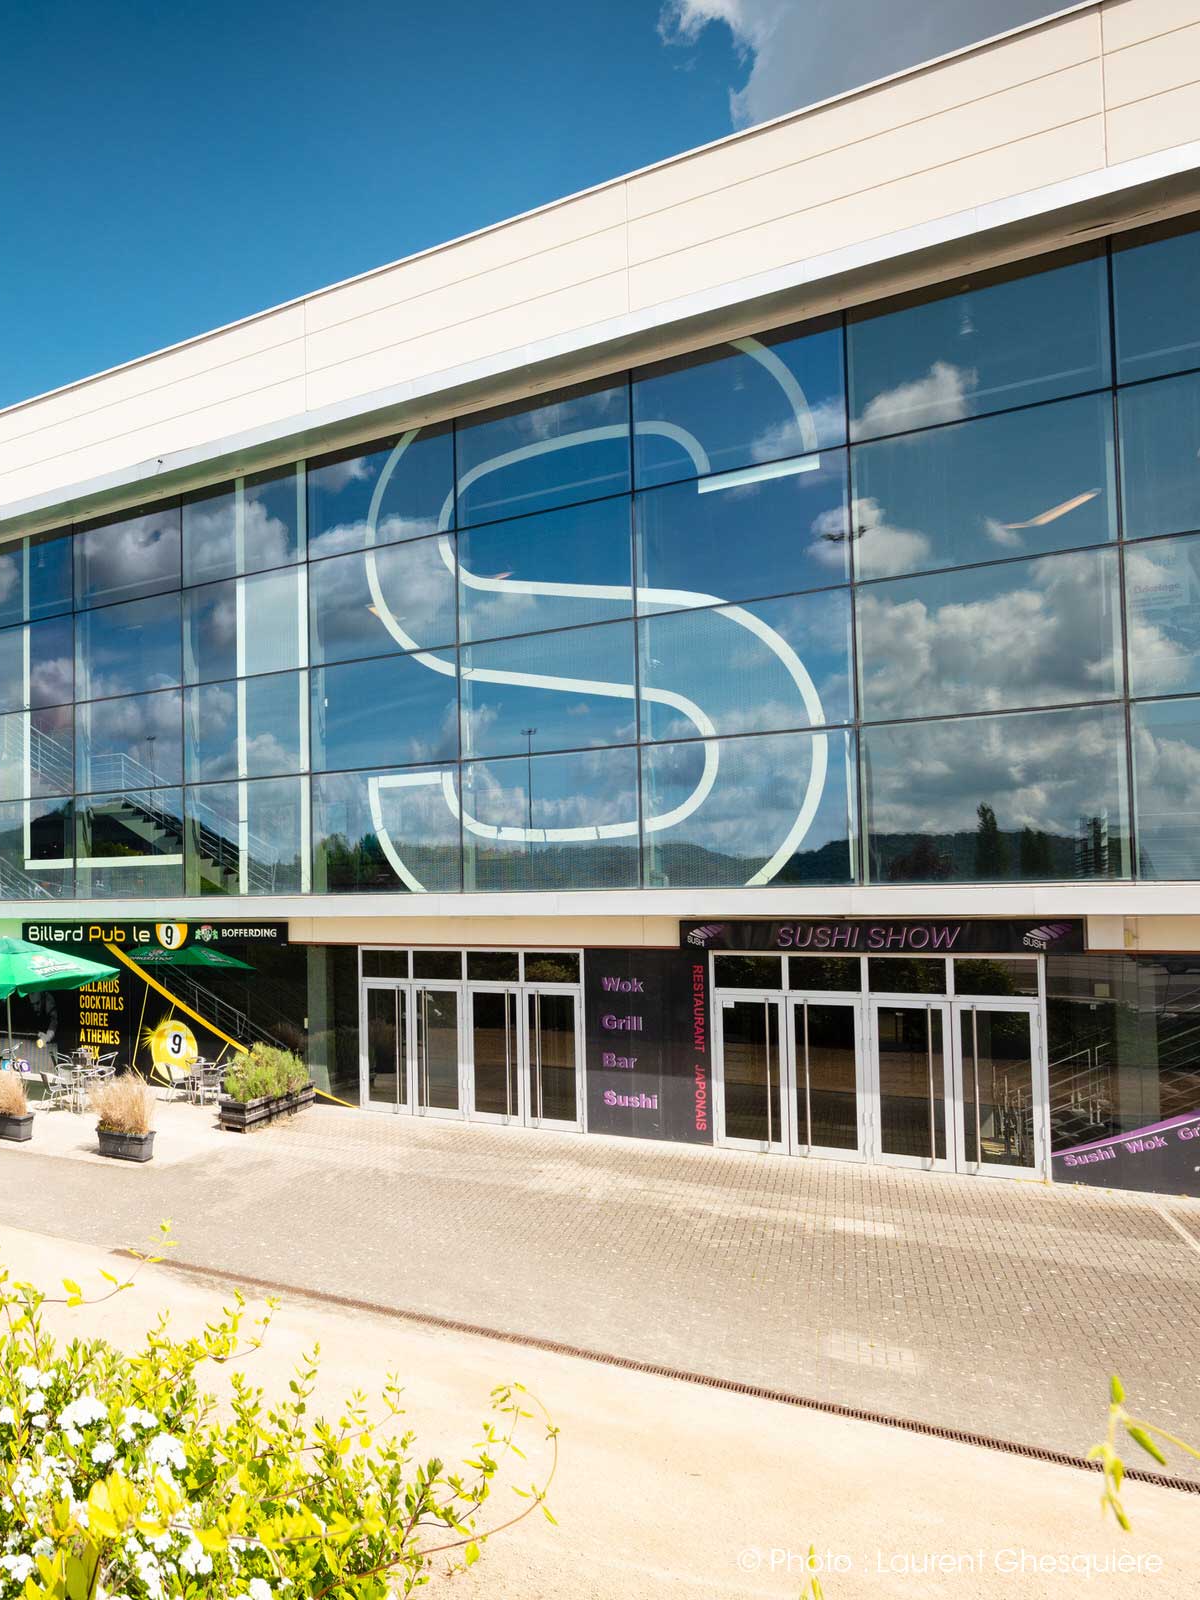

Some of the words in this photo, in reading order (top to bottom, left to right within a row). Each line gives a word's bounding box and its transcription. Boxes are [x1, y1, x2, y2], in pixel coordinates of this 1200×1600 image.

[28, 925, 83, 942] Billard
[89, 926, 126, 943] Pub
[133, 926, 150, 942] le
[164, 925, 174, 946] 9
[221, 927, 278, 938] BOFFERDING
[777, 926, 861, 947] SUSHI
[867, 926, 960, 948] SHOW
[687, 936, 705, 947] SUSHI
[1023, 936, 1047, 950] SUSHI
[602, 977, 644, 993] Wok
[80, 994, 124, 1011] COCKTAILS
[692, 965, 705, 1053] RESTAURANT
[80, 1011, 108, 1027] SOIREE
[602, 1014, 643, 1031] Grill
[80, 1028, 85, 1042] A
[86, 1029, 120, 1045] THEMES
[171, 1033, 182, 1055] 9
[602, 1052, 638, 1069] Bar
[603, 1089, 658, 1110] Sushi
[695, 1064, 707, 1132] JAPONAIS
[1063, 1146, 1117, 1167] Sushi
[1125, 1136, 1168, 1154] Wok
